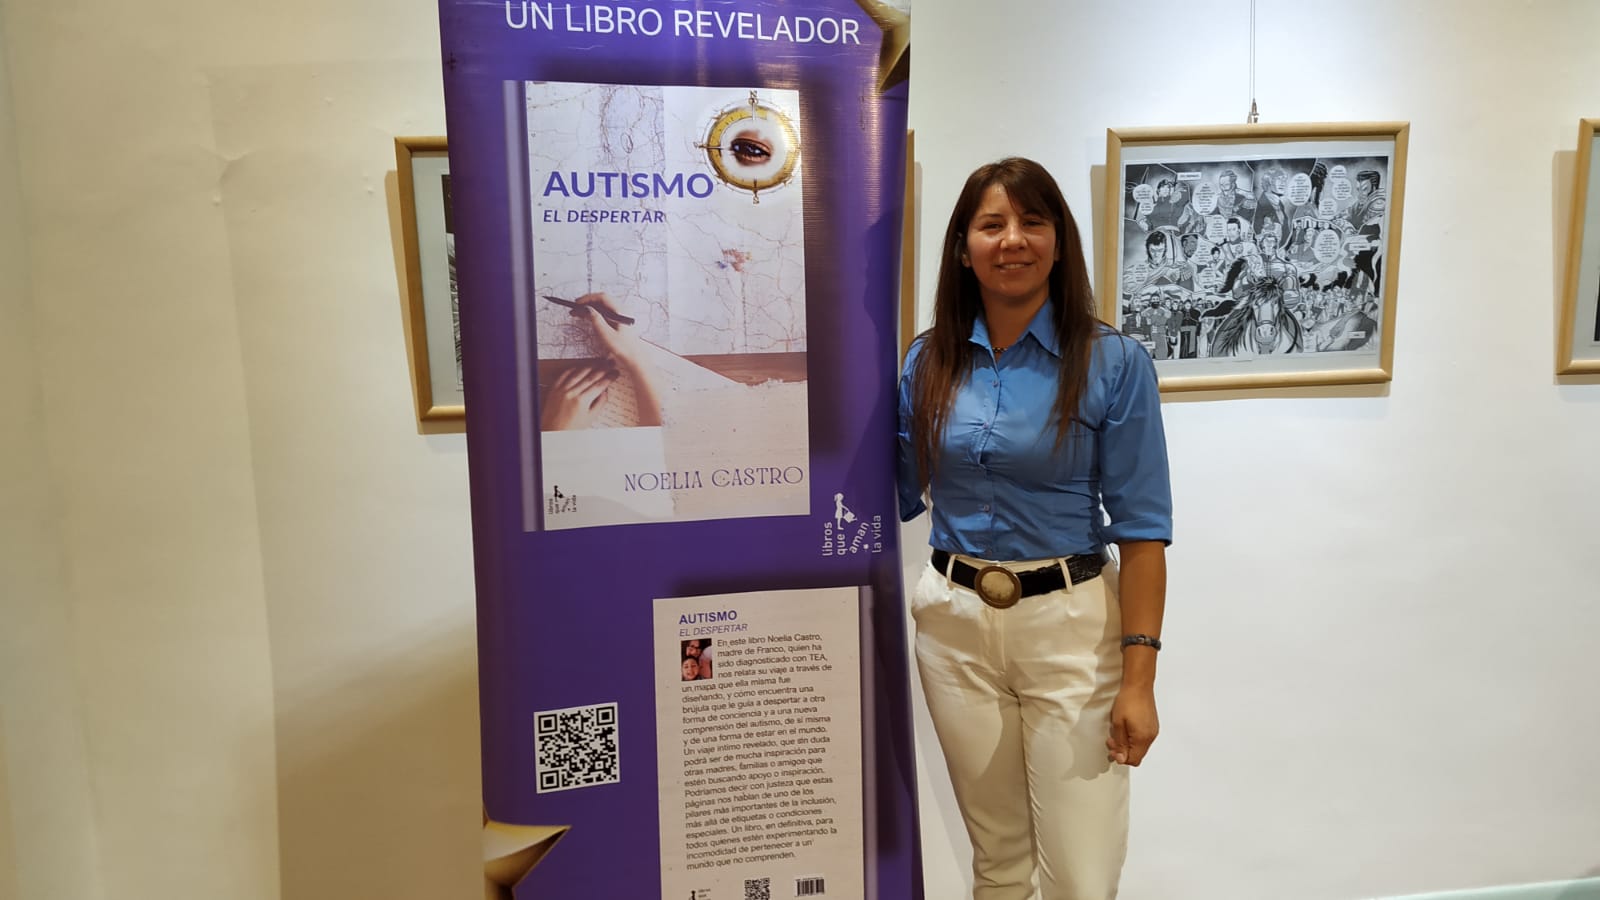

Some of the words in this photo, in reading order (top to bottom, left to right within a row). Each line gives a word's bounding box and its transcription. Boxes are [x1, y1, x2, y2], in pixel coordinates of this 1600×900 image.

[504, 0, 553, 30] UN
[566, 4, 662, 36] LIBRO
[674, 10, 861, 45] REVELADOR
[543, 171, 714, 198] AUTISMO
[543, 210, 562, 223] EL
[567, 210, 664, 223] DESPERTAR
[624, 472, 703, 491] NOELIA
[711, 466, 804, 488] CASTRO
[871, 515, 882, 539] vida
[822, 522, 833, 556] libros
[837, 534, 848, 556] que
[849, 522, 870, 554] aman
[872, 542, 882, 553] la
[679, 610, 737, 625] AUTISMO
[680, 629, 690, 637] EL
[693, 624, 748, 636] DESPERTAR
[716, 639, 727, 647] En
[767, 634, 792, 642] Noelia
[787, 644, 810, 653] quien
[735, 656, 790, 666] diagnosticado
[769, 666, 787, 674] viaje
[795, 664, 820, 672] través
[717, 682, 734, 690] que
[757, 687, 797, 695] encuentra
[710, 704, 727, 712] que
[762, 697, 800, 705] despertar
[719, 710, 762, 719] conciencia
[682, 723, 734, 734] comprensión
[683, 747, 696, 755] Un
[696, 746, 715, 754] viaje
[683, 757, 707, 767] podrá
[735, 751, 762, 759] mucha
[763, 747, 806, 757] inspiración
[739, 761, 768, 769] familias
[777, 758, 806, 766] amigos
[683, 778, 706, 786] estén
[707, 774, 747, 783] buscando
[748, 772, 772, 780] apoyo
[684, 799, 715, 809] páginas
[733, 793, 760, 801] hablan
[685, 809, 711, 819] pilares
[713, 806, 730, 814] más
[731, 802, 778, 812] importantes
[685, 820, 702, 828] más
[704, 818, 717, 826] allá
[731, 813, 766, 823] etiquetas
[775, 808, 822, 818] condiciones
[685, 841, 708, 849] todos
[710, 837, 740, 847] quienes
[742, 834, 764, 842] estén
[765, 828, 828, 840] experimentando
[686, 847, 737, 858] incomodidad
[750, 841, 793, 852] pertenecer
[686, 860, 714, 869] mundo
[715, 859, 731, 867] que
